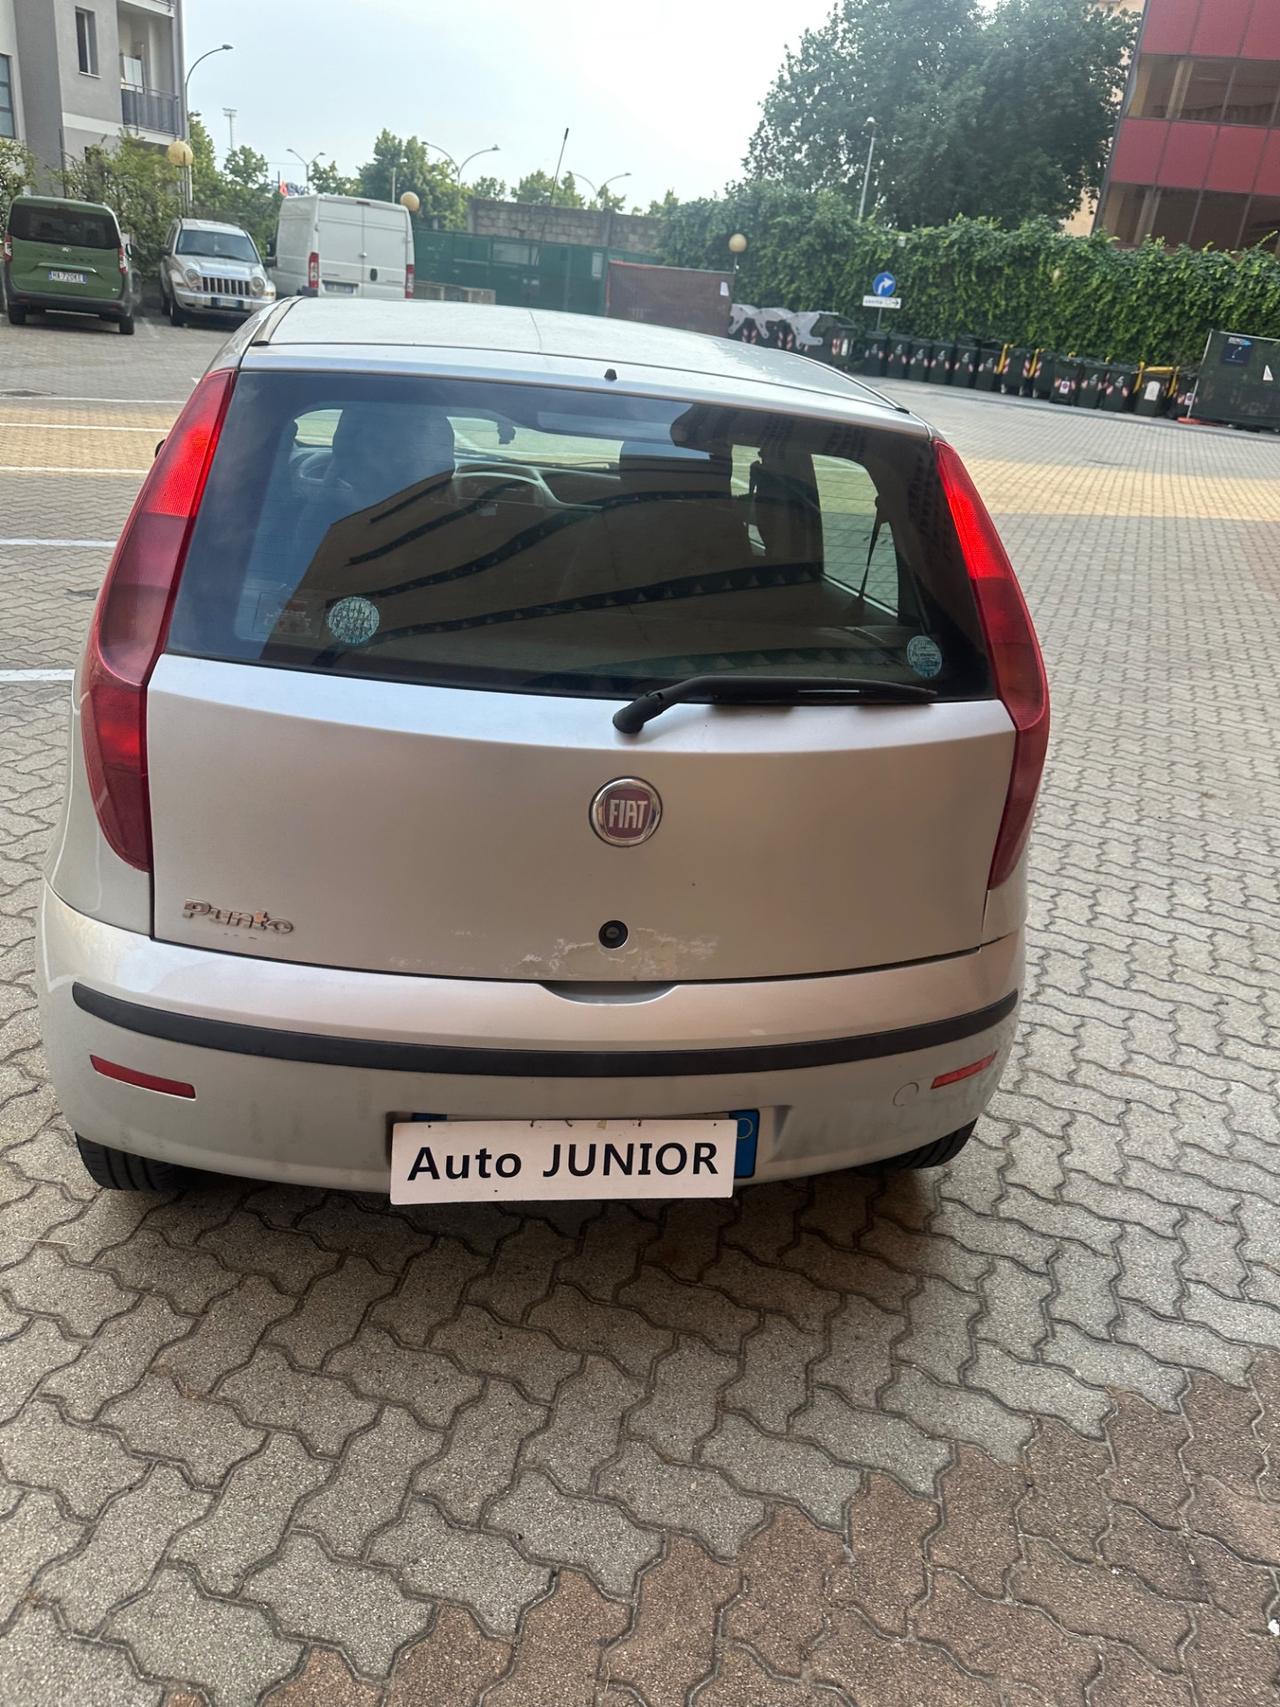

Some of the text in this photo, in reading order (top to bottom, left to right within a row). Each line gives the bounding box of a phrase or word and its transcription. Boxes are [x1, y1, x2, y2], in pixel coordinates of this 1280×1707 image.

[608, 799, 649, 829] FIAT
[182, 898, 295, 935] Punto
[407, 1141, 719, 1182] Auto JUNIOR
